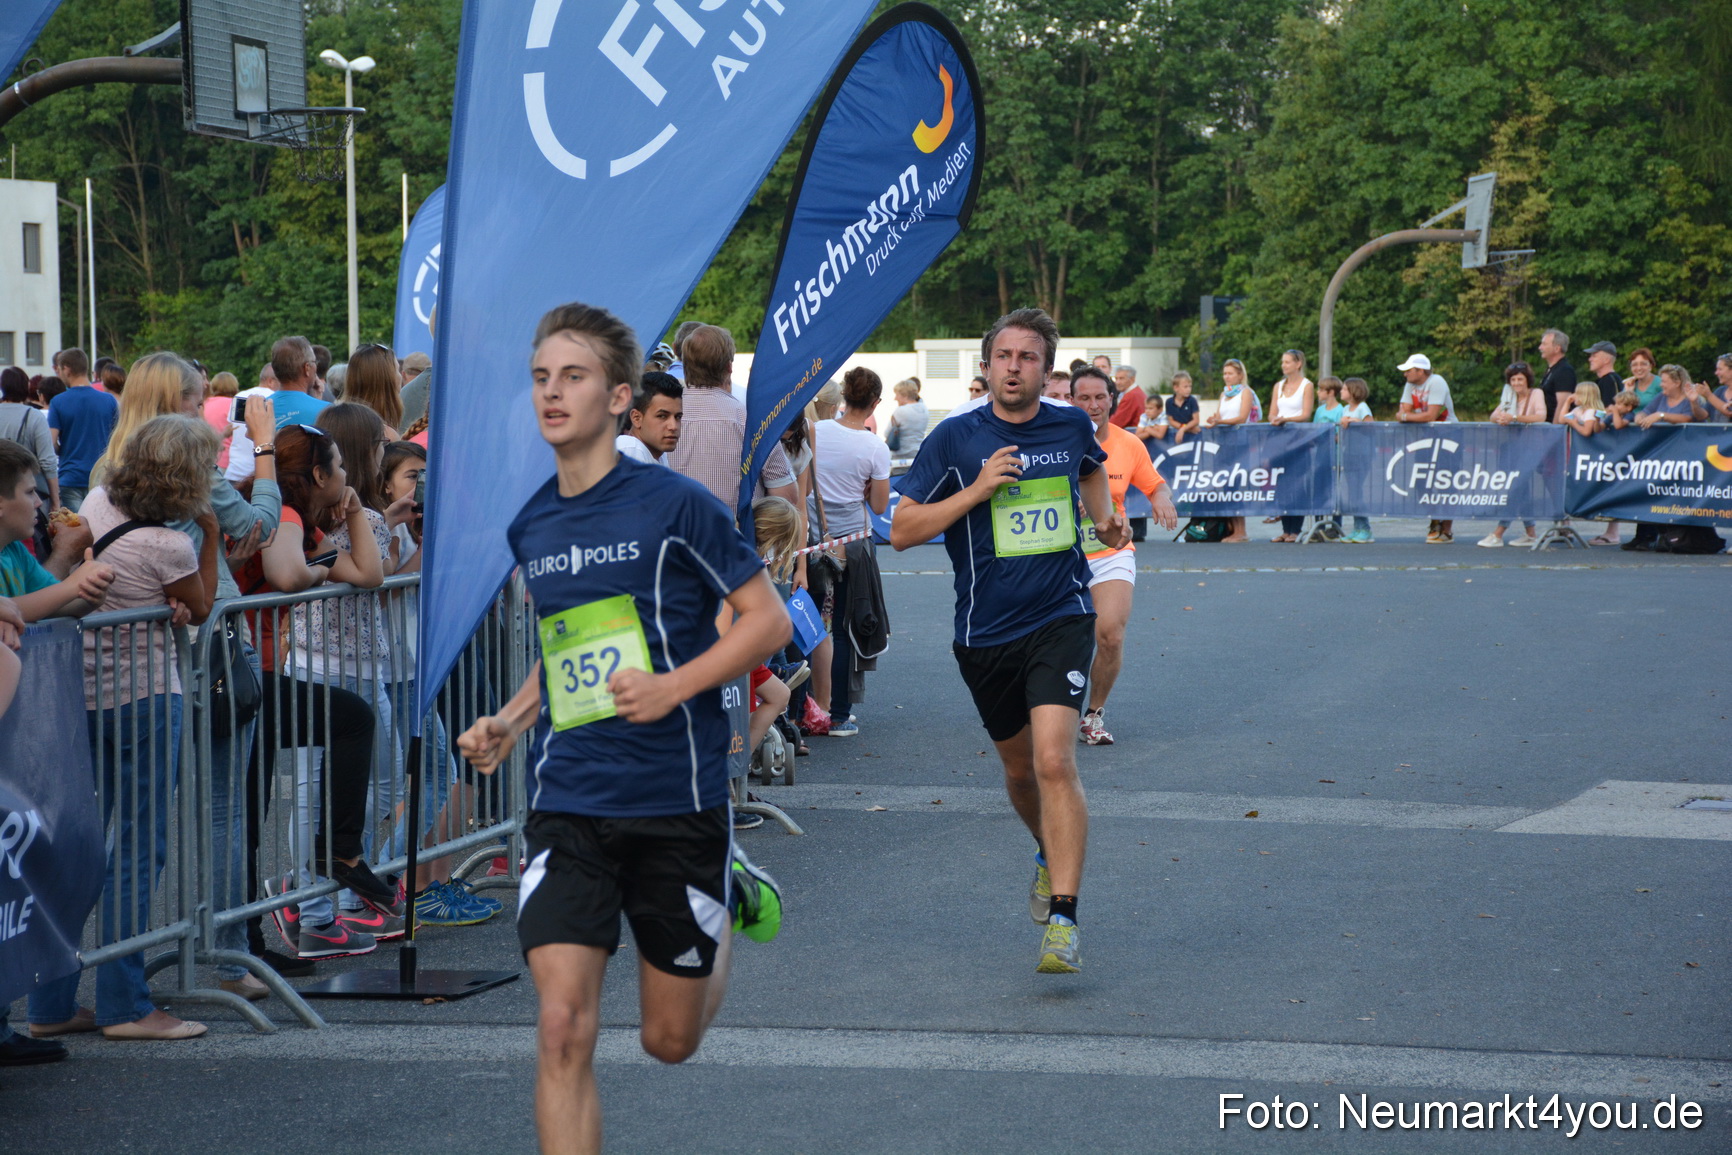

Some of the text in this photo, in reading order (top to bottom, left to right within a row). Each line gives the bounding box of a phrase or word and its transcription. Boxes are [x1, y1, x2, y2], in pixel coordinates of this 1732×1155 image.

[597, 0, 729, 107] Fi
[865, 224, 902, 276] Druck
[926, 142, 971, 208] Medien
[773, 164, 920, 354] Frischmann
[1032, 451, 1070, 466] POLES
[1575, 453, 1704, 482] Frischmann
[1172, 462, 1285, 490] Fischer
[1409, 463, 1520, 490] Fischer
[1647, 482, 1680, 497] Druck
[1681, 484, 1704, 498] und
[1177, 490, 1276, 503] AUTOMOBILE
[1419, 493, 1508, 505] AUTOMOBILE
[1010, 508, 1059, 535] 370
[528, 541, 640, 579] EURO POLES
[561, 646, 621, 694] 352
[0, 895, 34, 941] ILE
